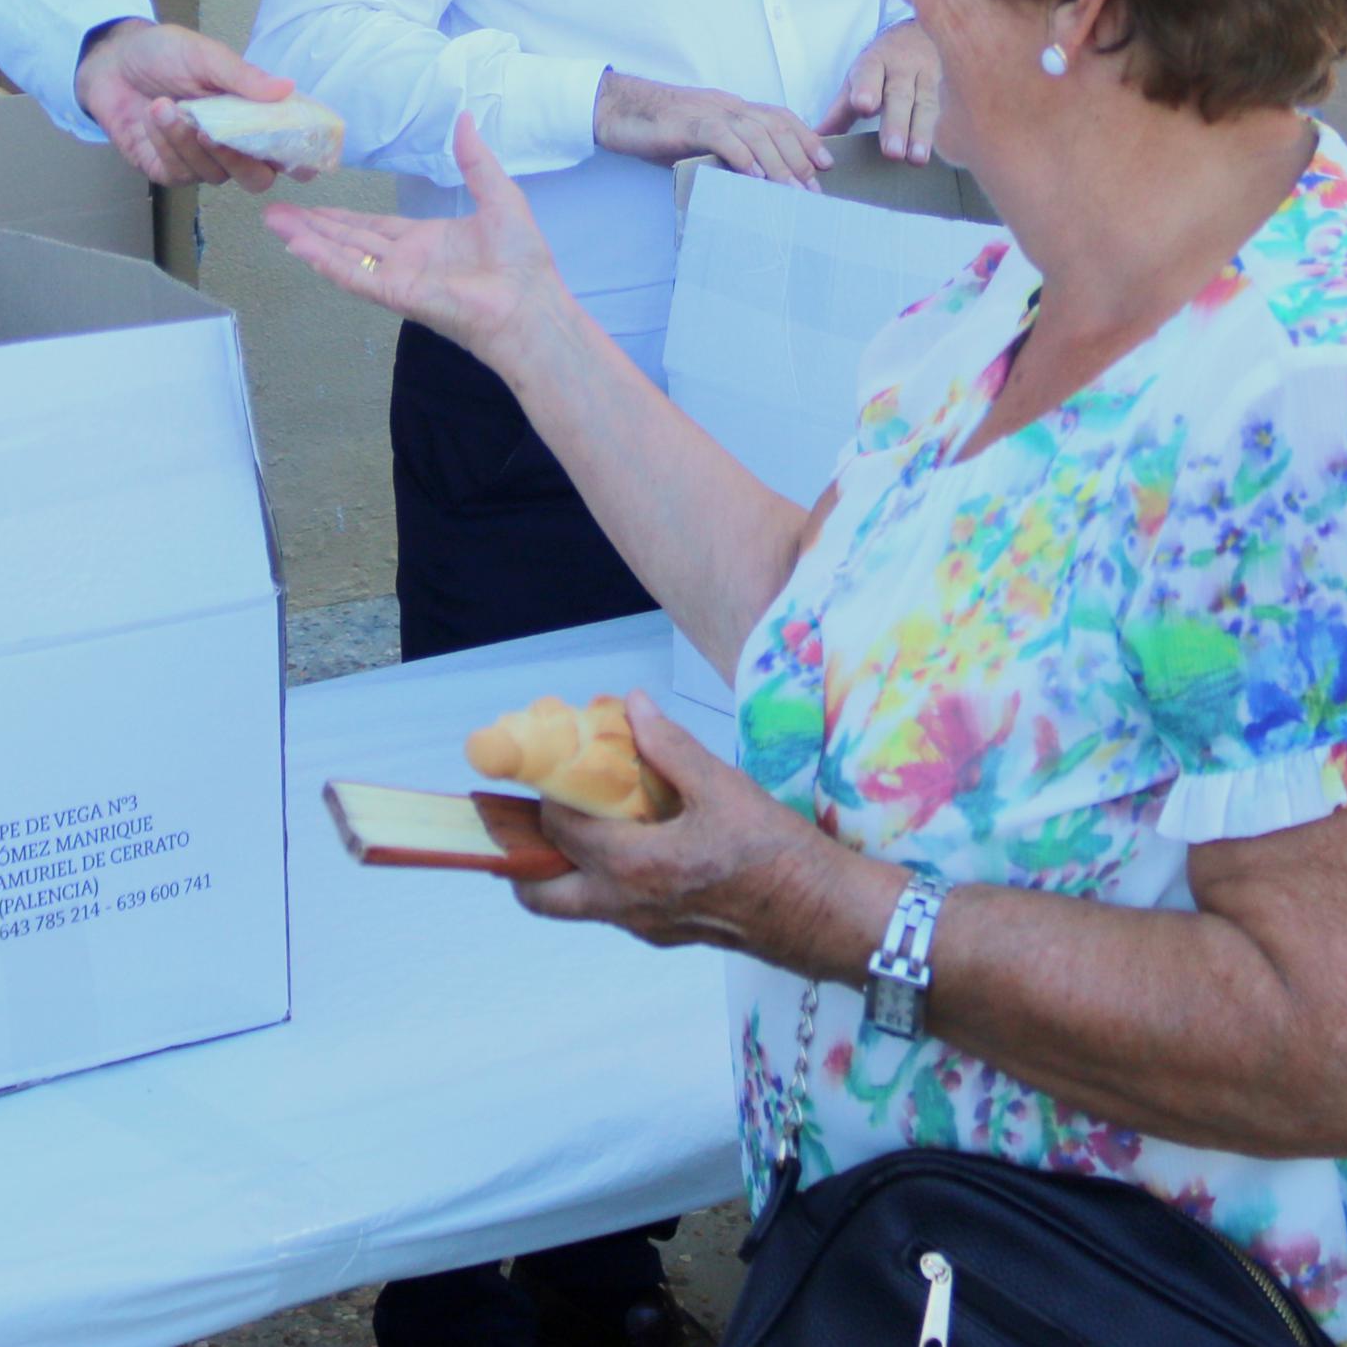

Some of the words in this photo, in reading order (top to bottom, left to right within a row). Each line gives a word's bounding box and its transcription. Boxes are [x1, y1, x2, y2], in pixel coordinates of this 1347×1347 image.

[25, 815, 51, 836] DE
[54, 803, 103, 829] VEGA
[56, 815, 153, 853] MANRIQUE
[82, 852, 105, 872] DE
[110, 831, 190, 865] CERRATO
[0, 919, 30, 941] 643
[35, 909, 65, 932] 785
[70, 902, 101, 924] 214
[116, 890, 146, 912] 639
[151, 882, 179, 903] 600
[184, 872, 212, 895] 741
